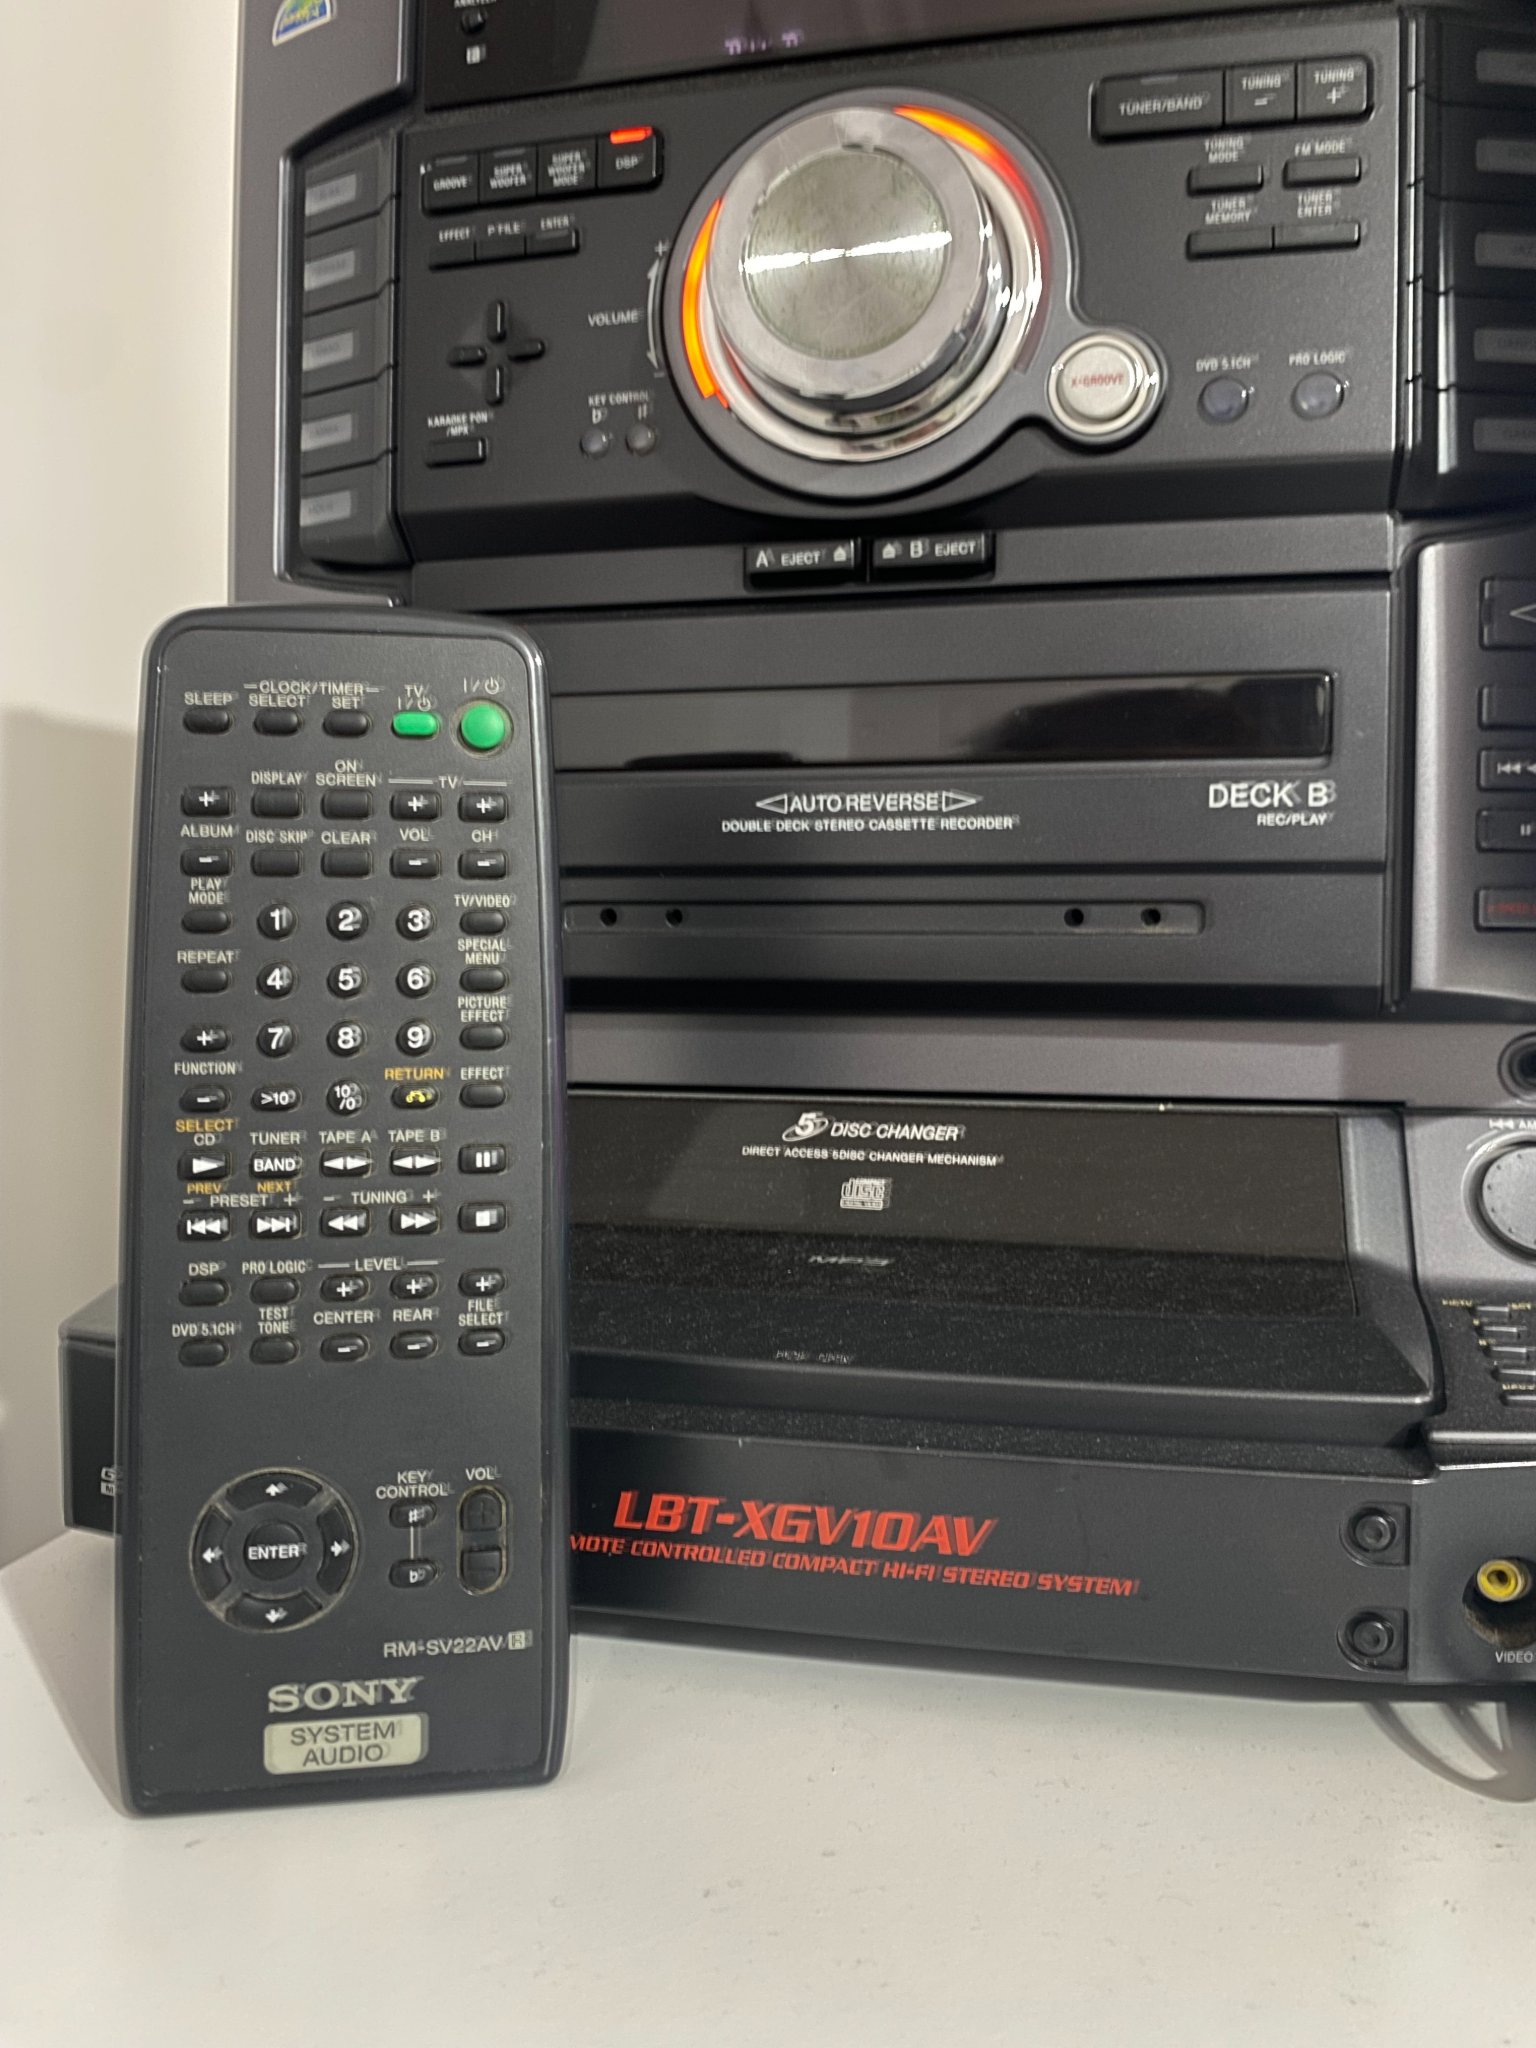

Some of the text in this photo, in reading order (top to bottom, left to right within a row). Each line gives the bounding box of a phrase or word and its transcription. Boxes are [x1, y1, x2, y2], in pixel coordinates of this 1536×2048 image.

[1242, 74, 1281, 90] TUNING
[1314, 69, 1354, 84] TUNING
[1119, 97, 1203, 116] TUNER/BAND
[1204, 138, 1244, 152] TUNING
[1295, 141, 1345, 156] FM MODE
[552, 151, 582, 164] SUPER
[1208, 151, 1239, 163] MODE
[494, 163, 522, 177] SUPER
[548, 162, 585, 177] WOOFER
[433, 175, 467, 191] GROOVE
[490, 174, 527, 189] WOOFER
[553, 175, 578, 187] MODE
[1212, 199, 1246, 211] TUNER
[540, 215, 570, 231] ENTER
[1206, 210, 1251, 225] MEMORY
[439, 227, 470, 243] EFFECT
[498, 222, 521, 235] FILE
[588, 311, 639, 327] VOLUME
[1196, 358, 1218, 373] DVD
[1289, 351, 1346, 367] PRO LOGIC
[588, 390, 649, 407] KEY CONTROL
[427, 412, 467, 427] KARAOKE
[910, 541, 976, 558] B EJECT
[756, 550, 821, 568] A EJECT
[260, 681, 364, 696] CLOCK/TIMER
[405, 685, 422, 697] TV
[184, 692, 232, 706] SLEEP
[249, 695, 306, 708] SELECT
[331, 696, 360, 709] SET
[335, 760, 357, 773] ON
[251, 771, 302, 786] DISPLAY
[316, 773, 376, 787] SCREEN
[439, 775, 458, 788] TV
[1209, 782, 1329, 808] DECK B
[790, 792, 939, 813] AUTO REVERSE
[722, 817, 1013, 833] DOUBLE DECK STEREO CASSETTE RECORDER
[1257, 812, 1327, 826] REC/PLAY
[181, 824, 233, 838] ALBUM
[246, 829, 307, 844] DISC SKIP
[321, 831, 371, 845] CLEAR
[400, 828, 429, 842] VOL
[471, 829, 492, 843] CH
[191, 878, 222, 891] PLAY
[189, 891, 224, 905] MODE
[454, 894, 510, 907] TV/VIDEO
[270, 909, 281, 930] 1
[338, 909, 353, 930] 2
[408, 910, 423, 931] 3
[457, 939, 506, 952] SPECIAL
[177, 950, 233, 964] REPEAT
[465, 952, 499, 965] MENU
[266, 968, 281, 989] 4
[338, 970, 354, 990] 5
[407, 969, 423, 990] 6
[457, 996, 506, 1009] PICTURE
[461, 1010, 504, 1022] EFFECT
[269, 1028, 284, 1049] 7
[338, 1028, 353, 1049] 8
[407, 1028, 422, 1049] 9
[174, 1062, 236, 1076] FUNCTION
[384, 1067, 444, 1081] RETURN
[461, 1067, 504, 1080] EFFECT
[176, 1119, 233, 1132] SELECT
[831, 1122, 872, 1138] DISC
[876, 1123, 959, 1142] CHANGER
[194, 1133, 216, 1146] CD
[250, 1131, 300, 1145] TUNER
[319, 1130, 372, 1144] TAPE A
[388, 1129, 440, 1143] TAPE B
[742, 1146, 781, 1157] DIRECT
[784, 1147, 828, 1159] ACCESS
[869, 1151, 924, 1163] CHANGER
[927, 1153, 997, 1166] MECHANISM
[254, 1158, 296, 1172] BAND
[187, 1182, 222, 1195] PREV
[257, 1181, 292, 1194] NEXT
[210, 1193, 268, 1208] PRESET
[352, 1190, 407, 1205] TUNING
[189, 1263, 219, 1276] DSP
[242, 1260, 306, 1274] PRO LOGIC
[355, 1257, 401, 1271] LEVEL
[468, 1299, 493, 1312] FILE
[259, 1307, 288, 1320] TEST
[313, 1311, 374, 1325] CENTER
[393, 1309, 432, 1322] REAR
[458, 1312, 504, 1326] SELECT
[172, 1323, 235, 1337] DVD 5.1CH
[258, 1320, 289, 1334] TONE
[397, 1471, 426, 1484] KEY
[466, 1468, 494, 1481] VOL
[376, 1484, 448, 1498] CONTROL
[613, 1490, 992, 1557] LBT-XGV10AV
[248, 1545, 299, 1560] ENTER
[570, 1534, 1134, 1597] MOTE CONTROLLED COMPACT HI-FI STEREO SYSTEM
[384, 1636, 504, 1657] RM-SV22AV
[1495, 1651, 1533, 1664] VIDEO
[268, 1677, 420, 1713] SONY
[291, 1722, 395, 1746] SYSTEM
[303, 1744, 383, 1767] AUDIO
